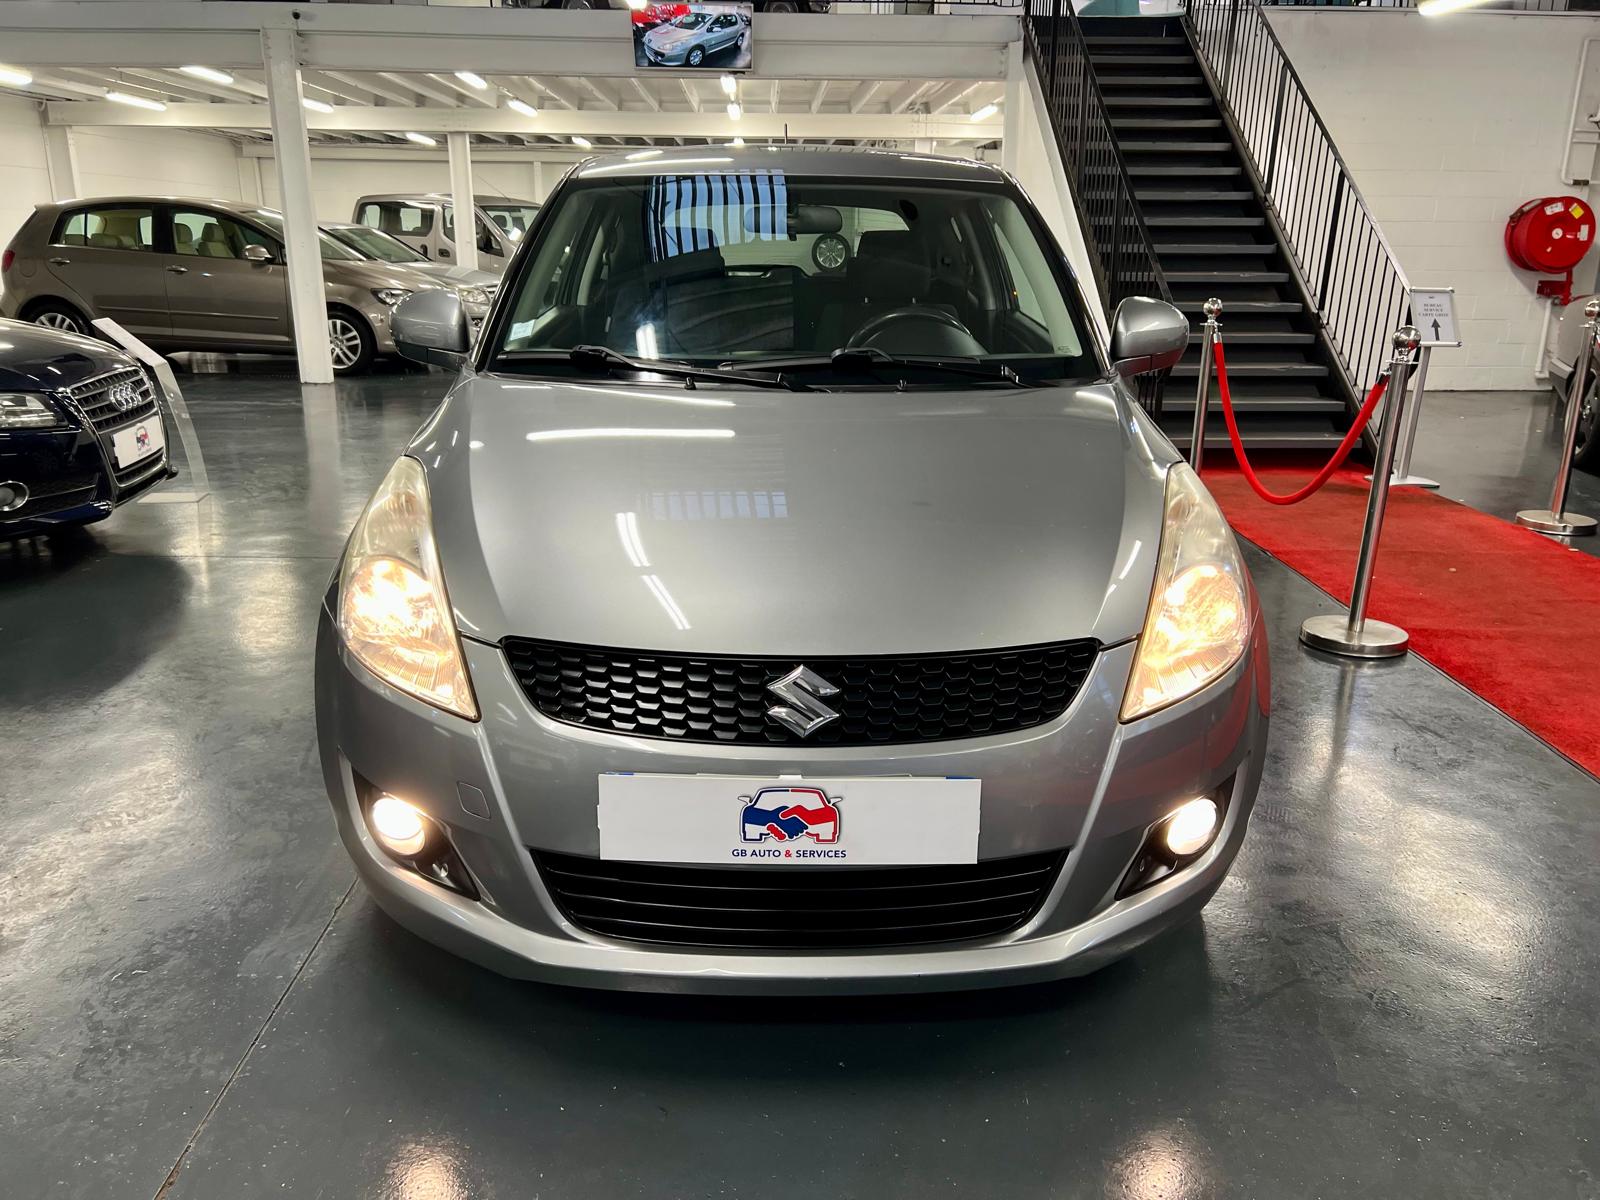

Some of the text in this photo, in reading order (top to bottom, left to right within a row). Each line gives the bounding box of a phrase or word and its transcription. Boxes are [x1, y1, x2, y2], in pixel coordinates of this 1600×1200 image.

[732, 848, 847, 858] GB AUTO & SERVICES
